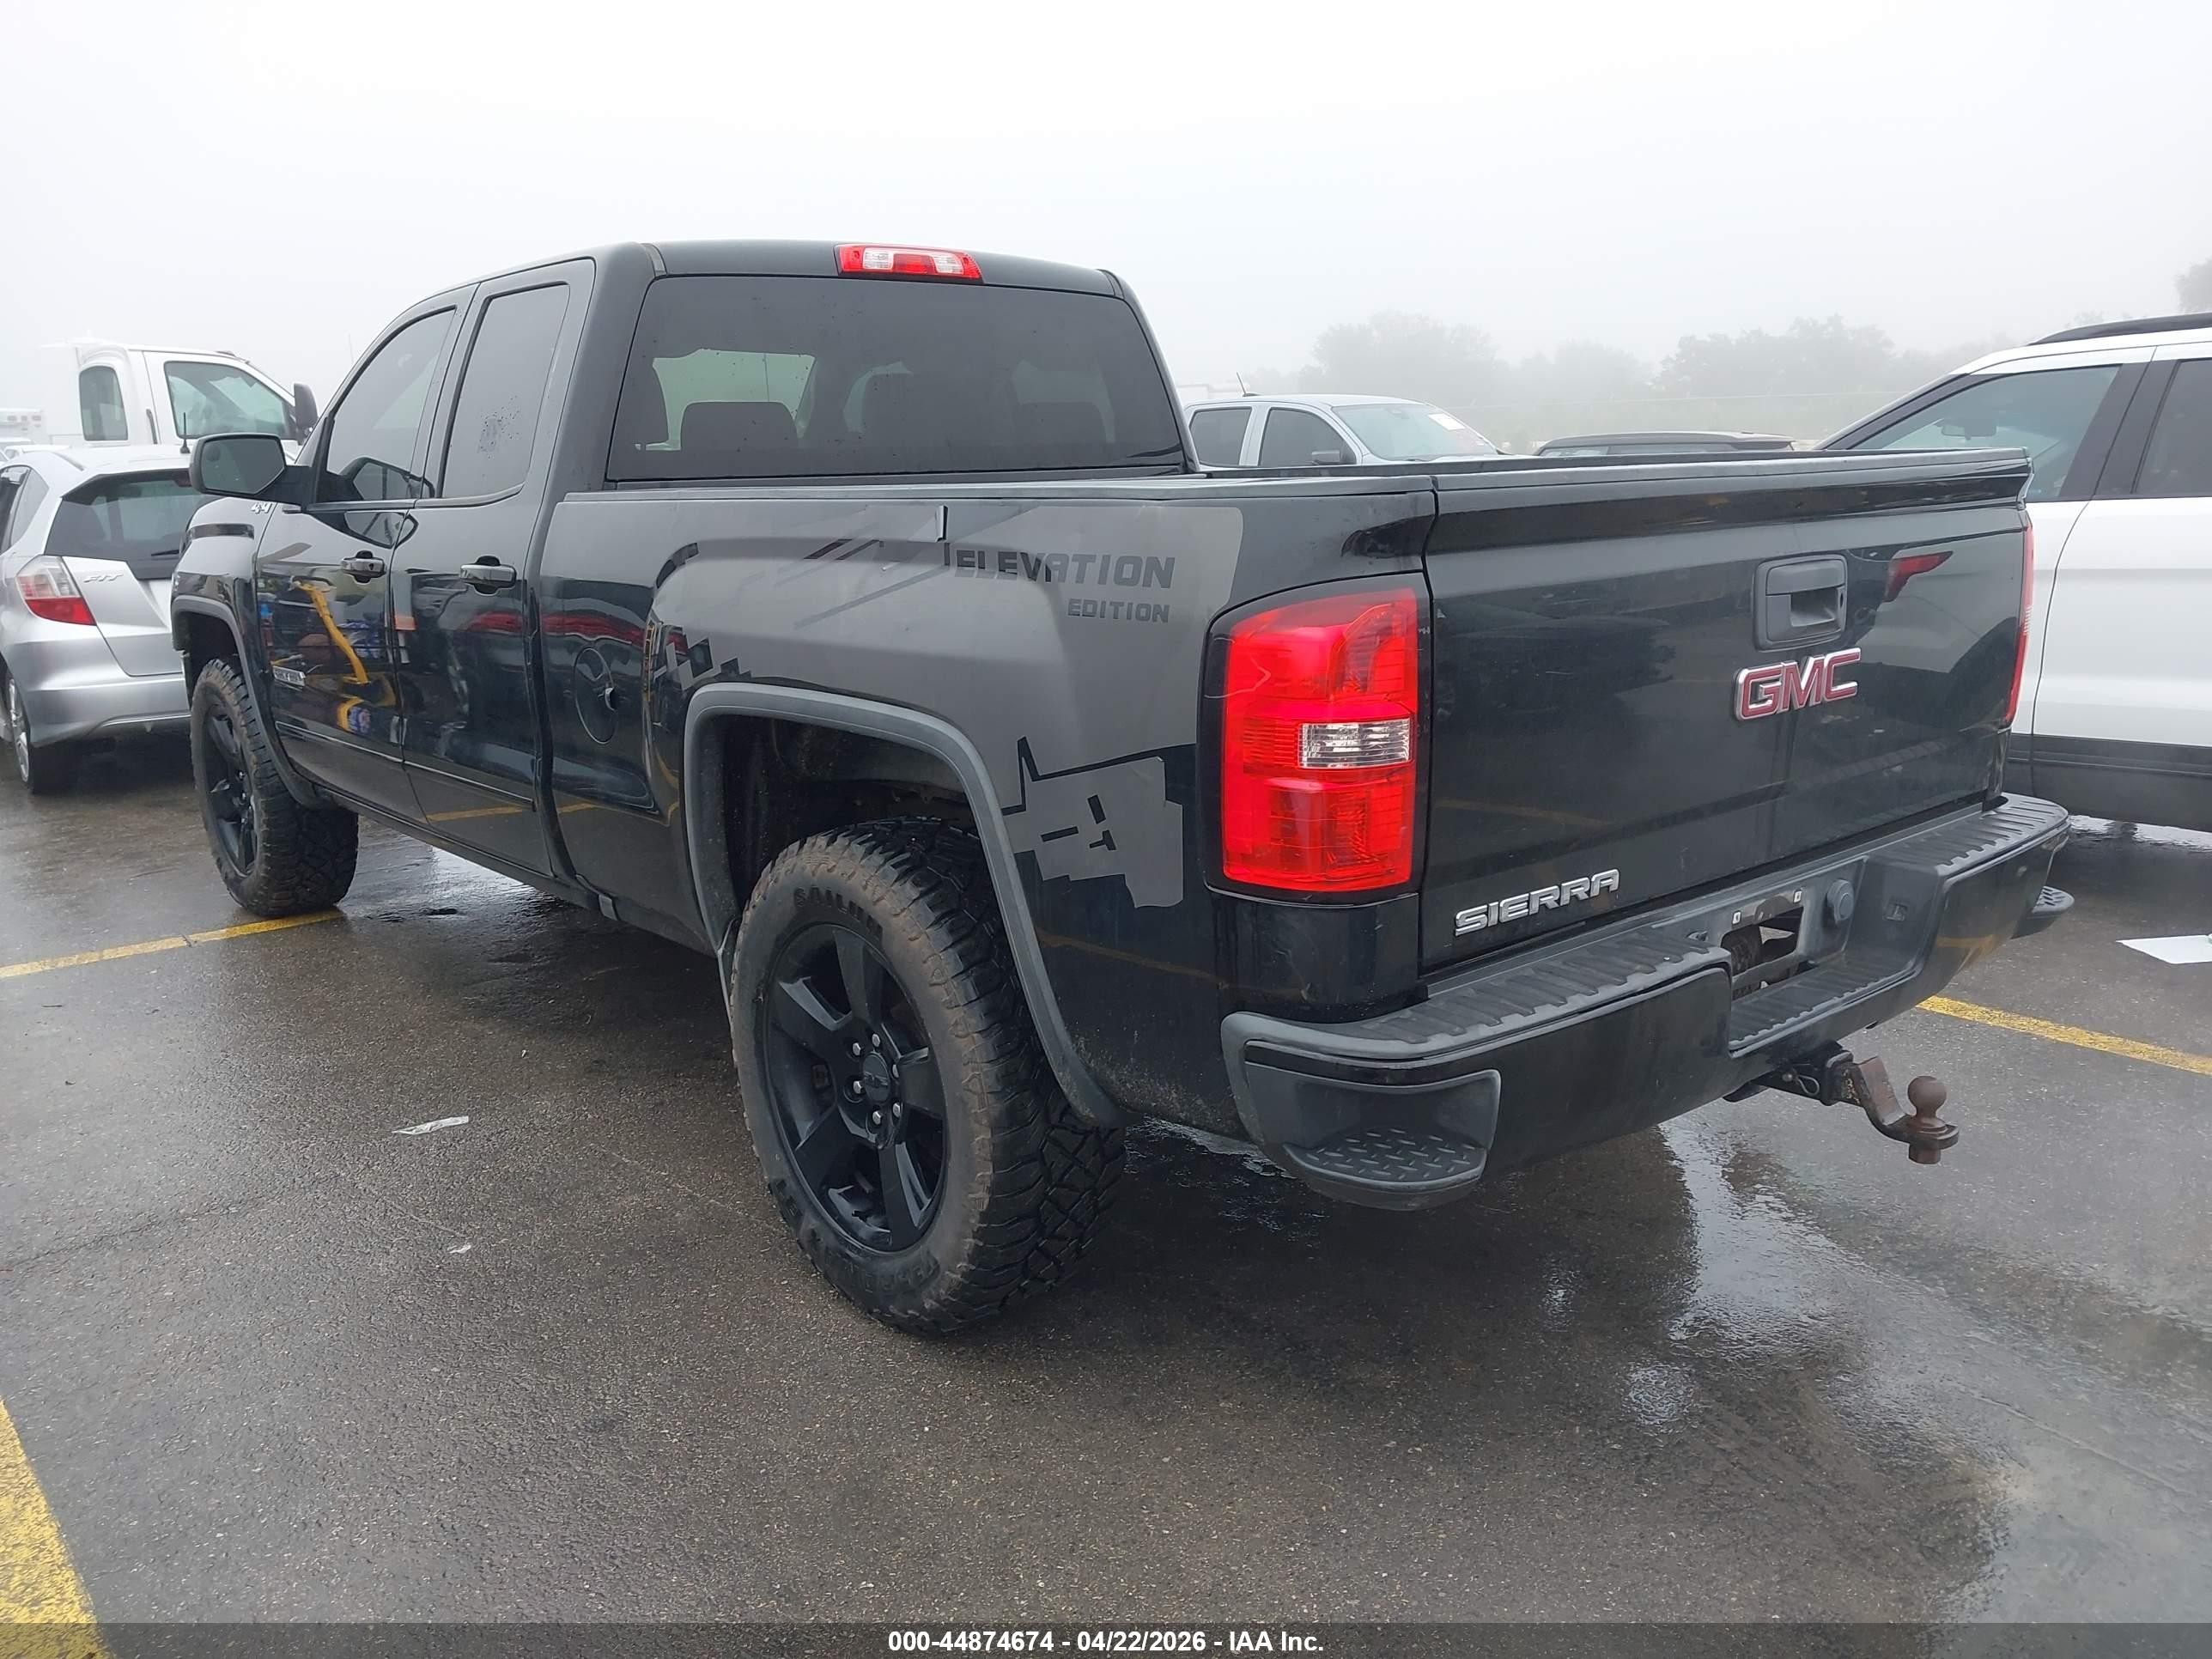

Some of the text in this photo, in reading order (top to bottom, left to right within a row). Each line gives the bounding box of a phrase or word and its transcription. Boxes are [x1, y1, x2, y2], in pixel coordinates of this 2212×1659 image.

[955, 549, 1176, 589] ELEVATION
[1067, 598, 1170, 623] EDITION
[1735, 647, 1862, 720] GMC
[1455, 868, 1620, 937] SIERRA
